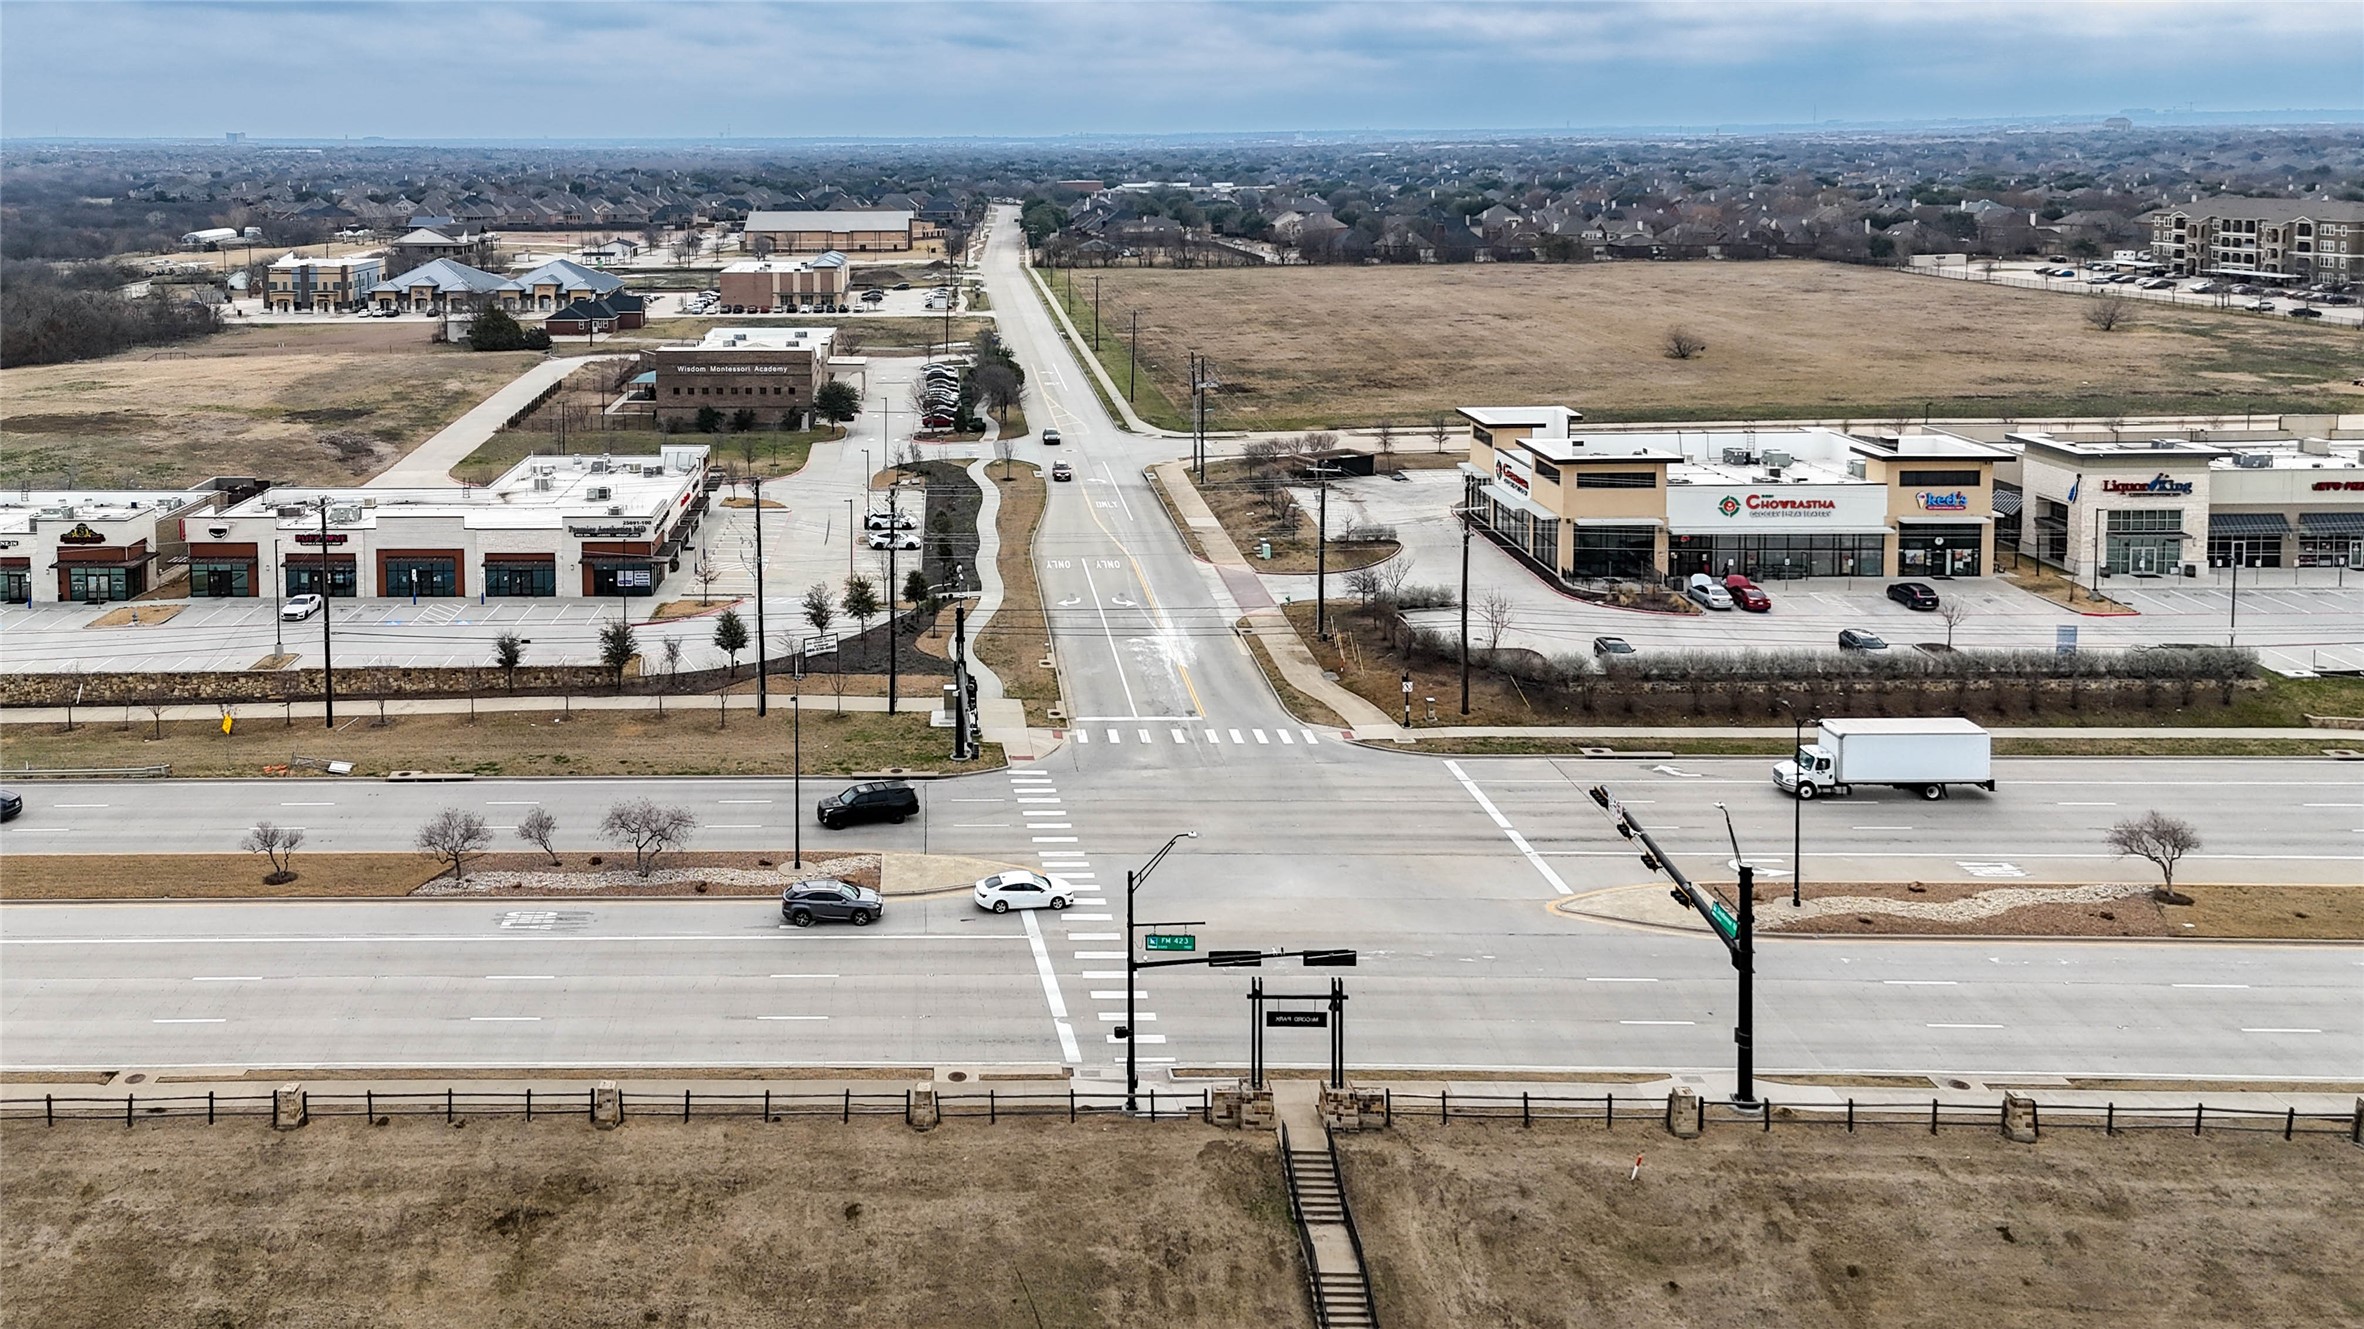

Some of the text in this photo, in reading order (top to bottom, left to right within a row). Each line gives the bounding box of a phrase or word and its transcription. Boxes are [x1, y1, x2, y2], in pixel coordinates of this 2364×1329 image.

[754, 366, 788, 374] Academy
[2102, 476, 2193, 495] Liquor King
[1047, 560, 1071, 569] ONLY
[1096, 560, 1120, 569] ONLY
[1173, 937, 1189, 945] 423
